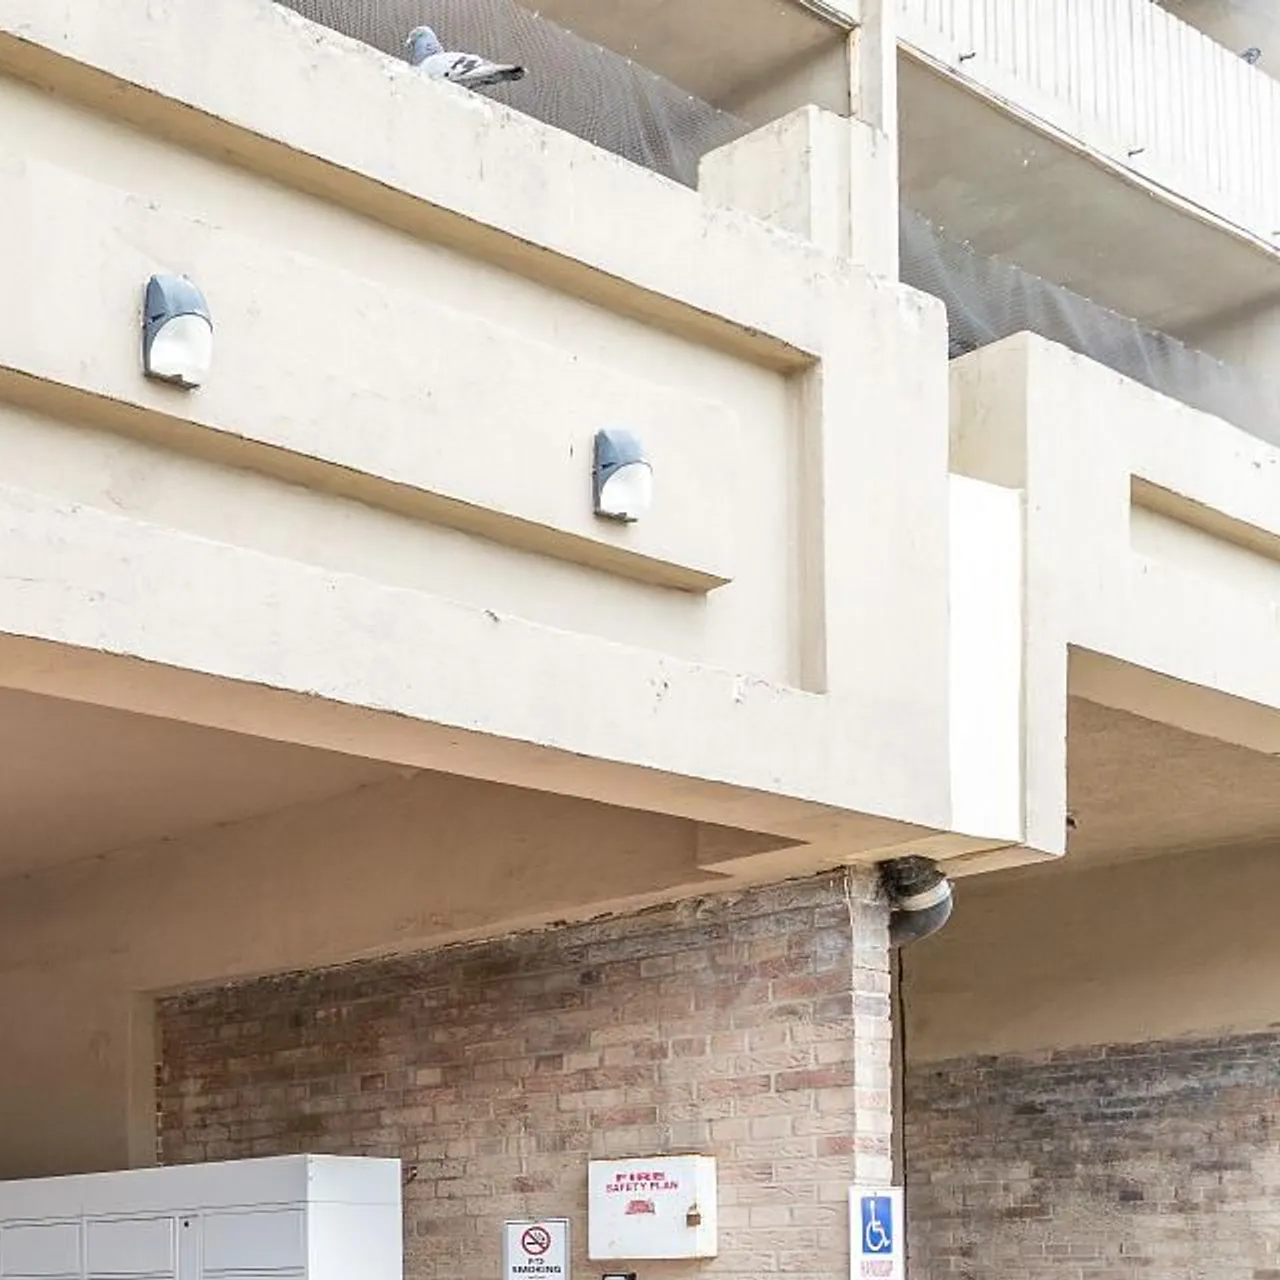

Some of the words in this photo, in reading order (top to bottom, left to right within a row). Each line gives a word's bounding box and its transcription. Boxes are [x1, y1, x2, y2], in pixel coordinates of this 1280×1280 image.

[616, 1172, 664, 1182] FIRE
[606, 1182, 647, 1193] SAFETY
[650, 1181, 678, 1190] PLAN
